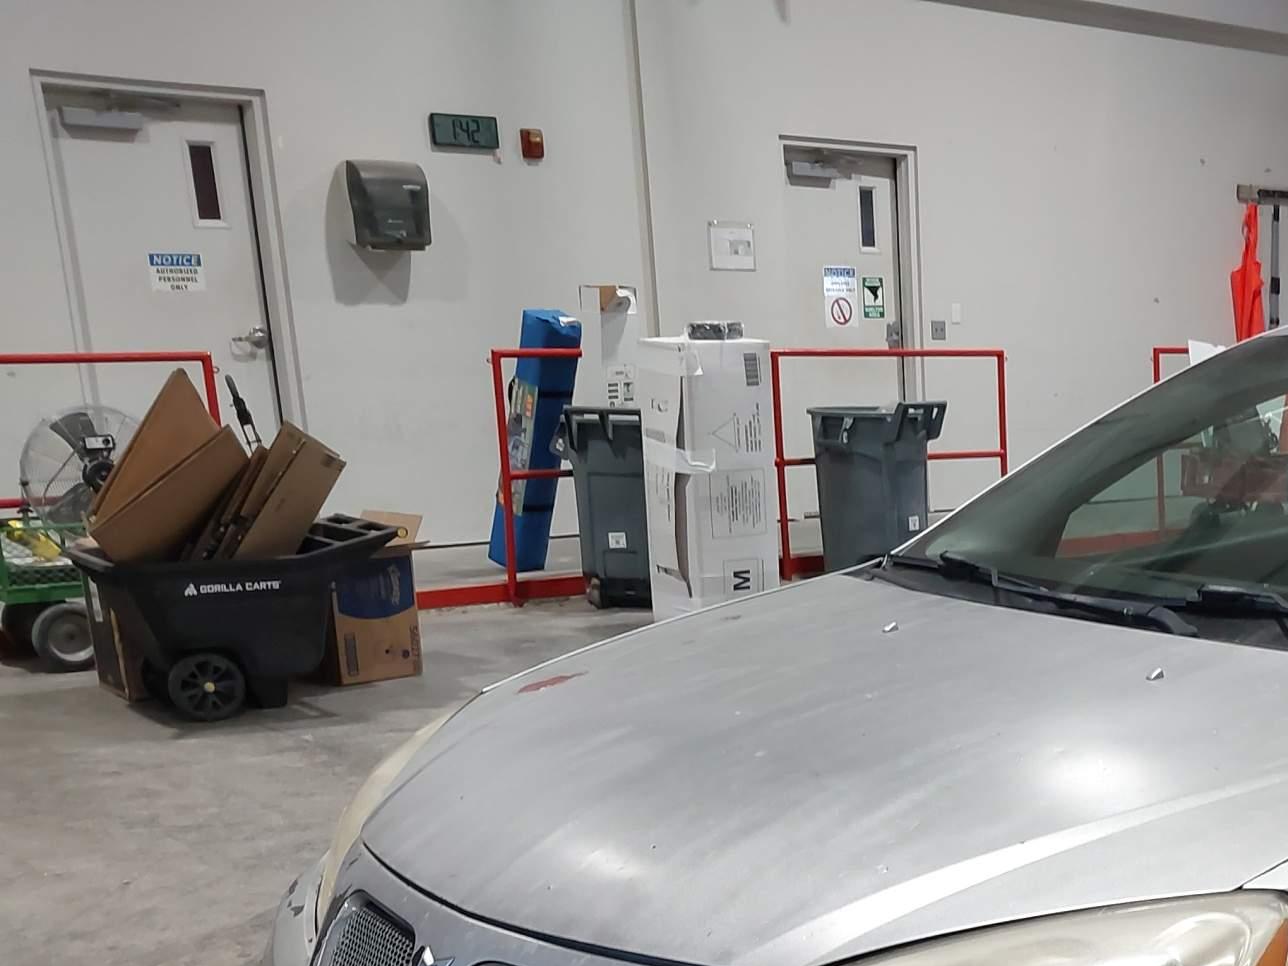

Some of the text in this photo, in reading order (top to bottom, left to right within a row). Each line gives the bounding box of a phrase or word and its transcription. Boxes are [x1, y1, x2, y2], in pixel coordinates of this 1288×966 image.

[153, 255, 199, 265] NOTICE
[200, 580, 282, 594] GORILLA CARTS
